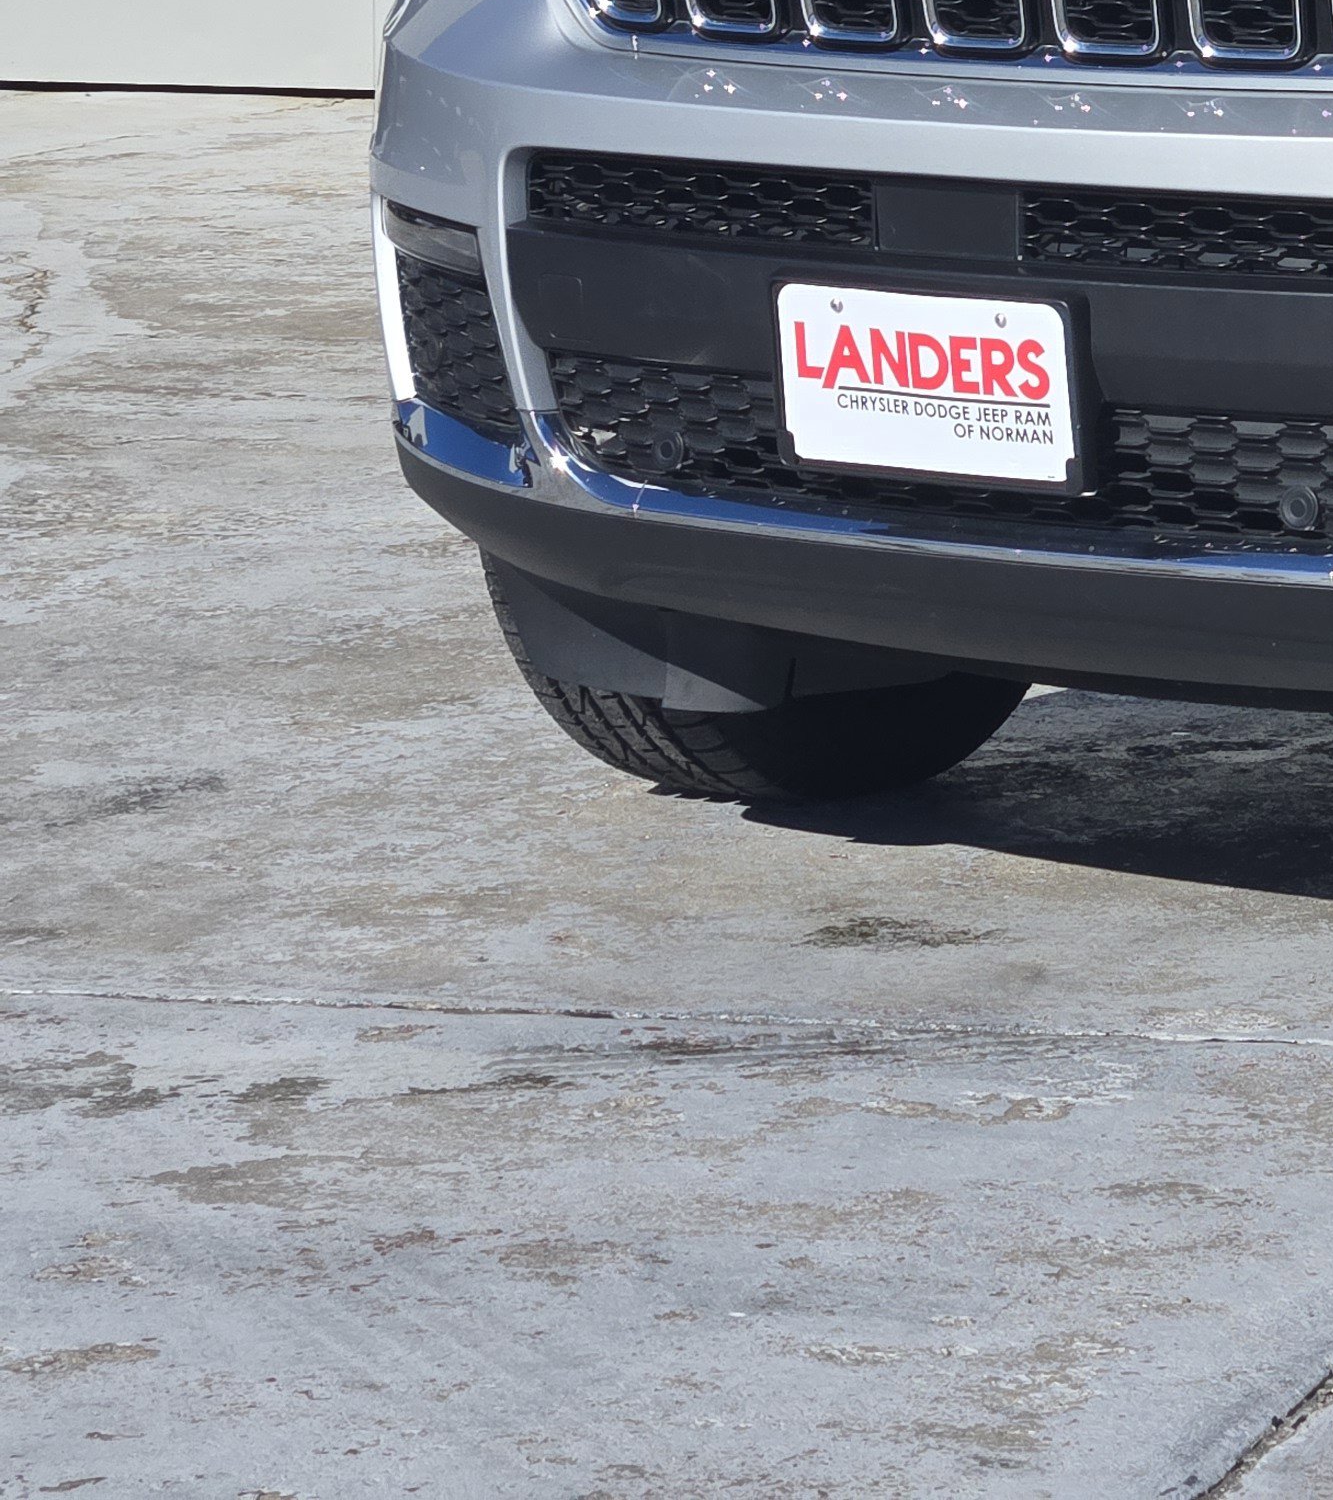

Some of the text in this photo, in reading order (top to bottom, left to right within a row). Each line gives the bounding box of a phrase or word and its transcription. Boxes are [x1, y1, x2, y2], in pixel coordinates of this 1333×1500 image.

[795, 321, 1051, 400] LANDERS
[837, 393, 1052, 427] CHRYSLER DODGE JEEP RAM
[954, 423, 1054, 445] OF NORMAN
